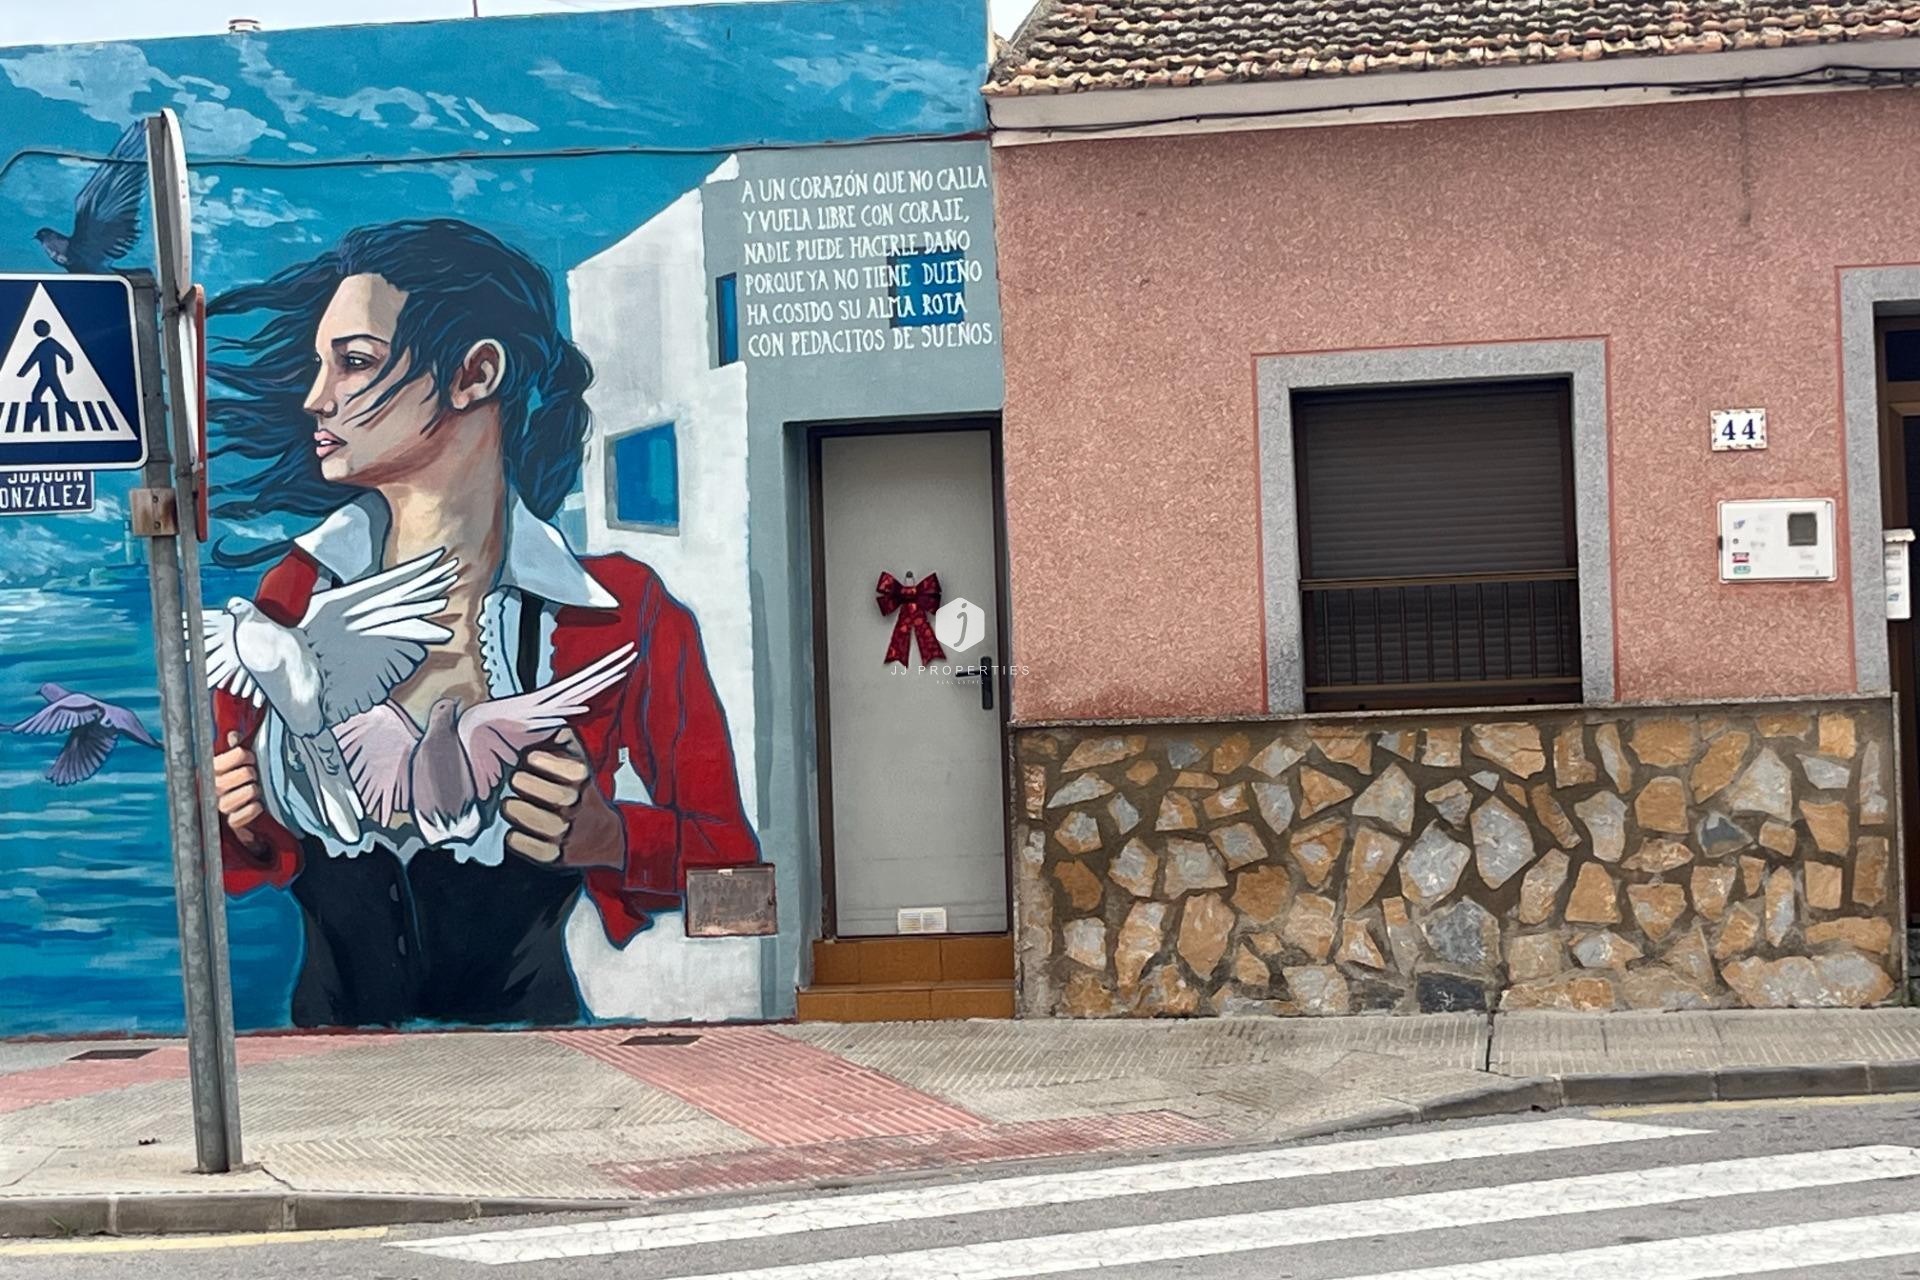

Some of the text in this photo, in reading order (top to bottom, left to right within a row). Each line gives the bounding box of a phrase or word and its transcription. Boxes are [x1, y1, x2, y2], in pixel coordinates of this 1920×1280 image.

[742, 165, 988, 203] A UN CORAZÓN QUE NO CALLA
[743, 197, 970, 233] Y VUELA LIBRE CON CORAJE,
[744, 239, 791, 265] NADIE
[796, 237, 844, 261] PUEDE
[850, 233, 918, 258] HACERLE
[746, 270, 804, 295] PORQUE
[807, 269, 829, 291] YA
[834, 268, 858, 290] NO
[863, 263, 911, 289] TIENE
[747, 292, 967, 326] HA COSIDO SU ALMA ROTA
[749, 332, 784, 357] CON
[791, 328, 885, 355] PEDACITOS
[893, 326, 914, 350] DE
[1722, 418, 1756, 440] 44
[0, 483, 86, 509] ONZÁLEZ
